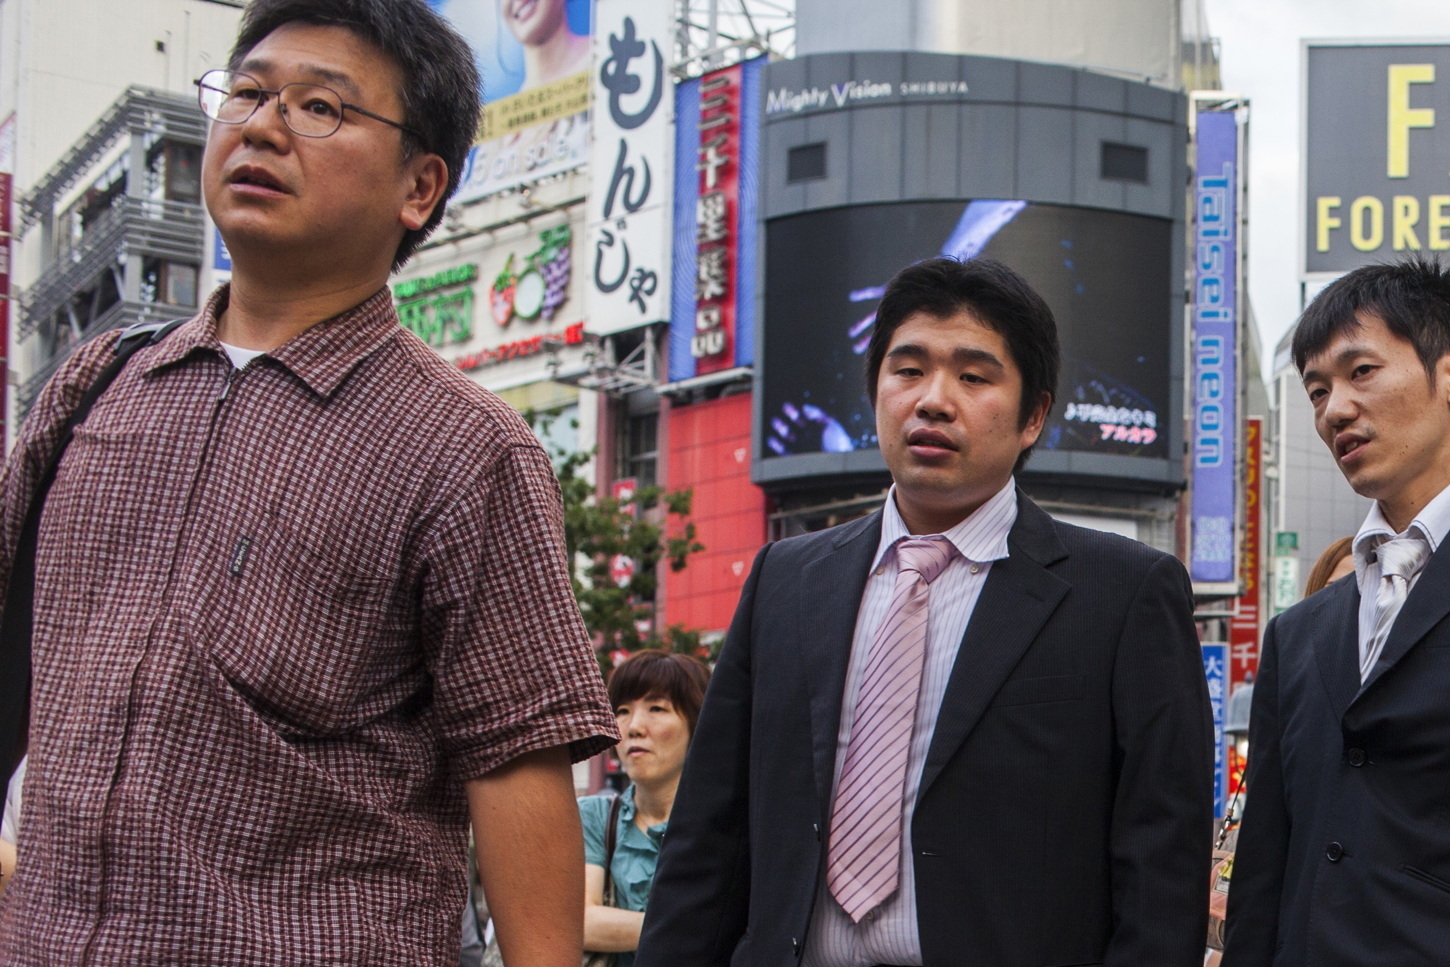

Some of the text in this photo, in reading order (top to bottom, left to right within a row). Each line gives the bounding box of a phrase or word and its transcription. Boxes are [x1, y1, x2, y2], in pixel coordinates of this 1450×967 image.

[594, 15, 664, 314] もんじゃ
[766, 78, 969, 114] Mighty Vision SHIBUYA
[1196, 162, 1234, 469] Taisei neon
